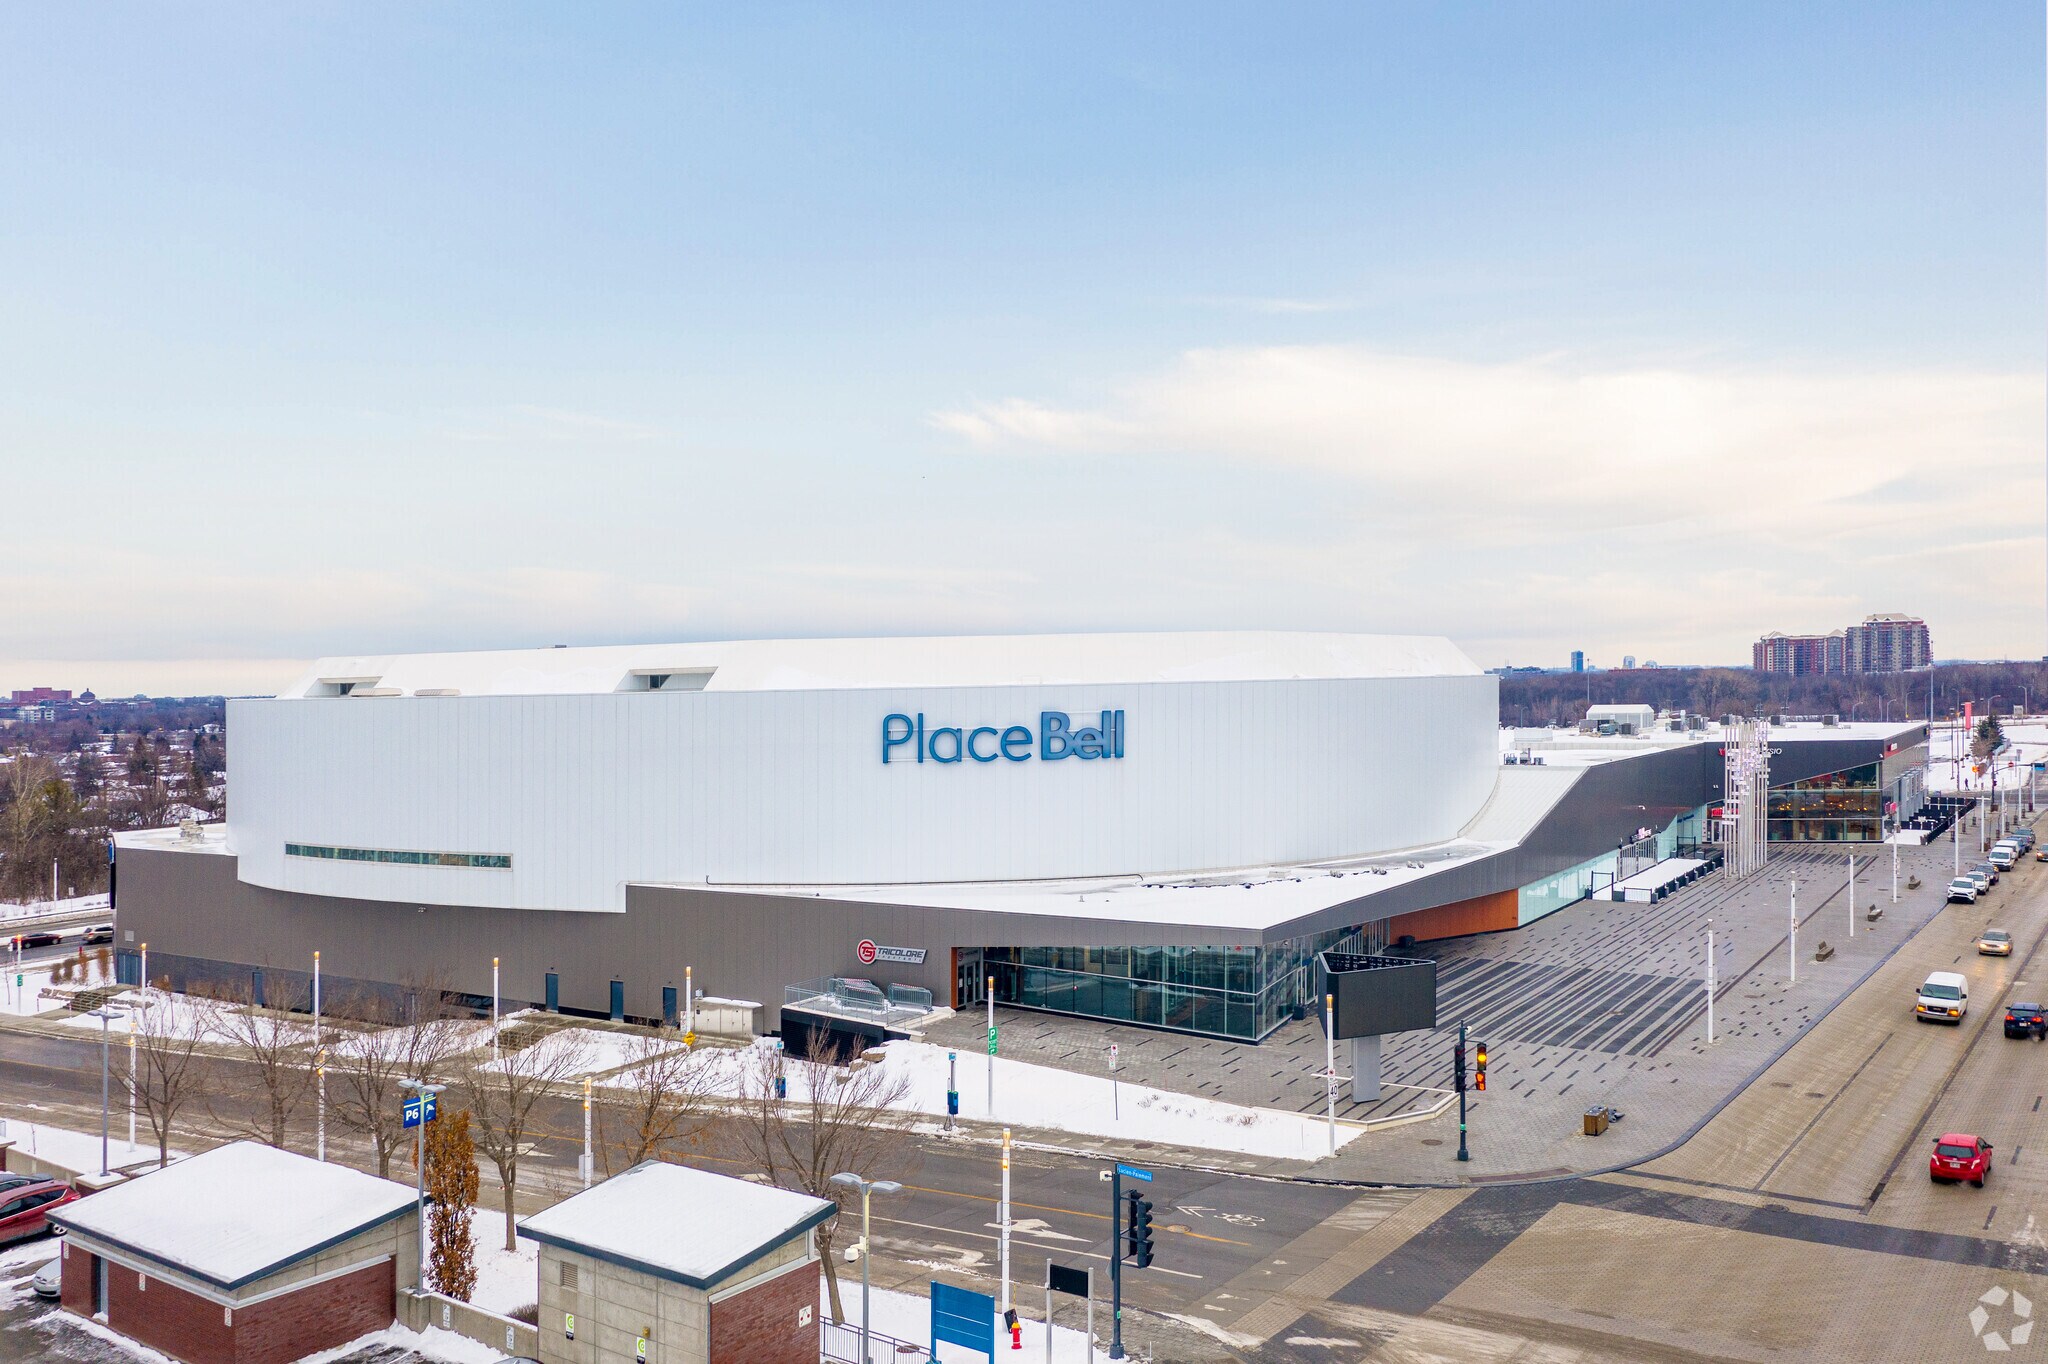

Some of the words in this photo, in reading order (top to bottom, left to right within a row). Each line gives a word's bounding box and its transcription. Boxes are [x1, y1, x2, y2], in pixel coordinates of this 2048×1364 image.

[883, 712, 1033, 764] Place
[1041, 709, 1124, 761] Bell
[878, 947, 924, 959] TRICOLORE
[990, 1028, 996, 1040] P
[1330, 1085, 1337, 1096] 40
[405, 1107, 419, 1121] P6
